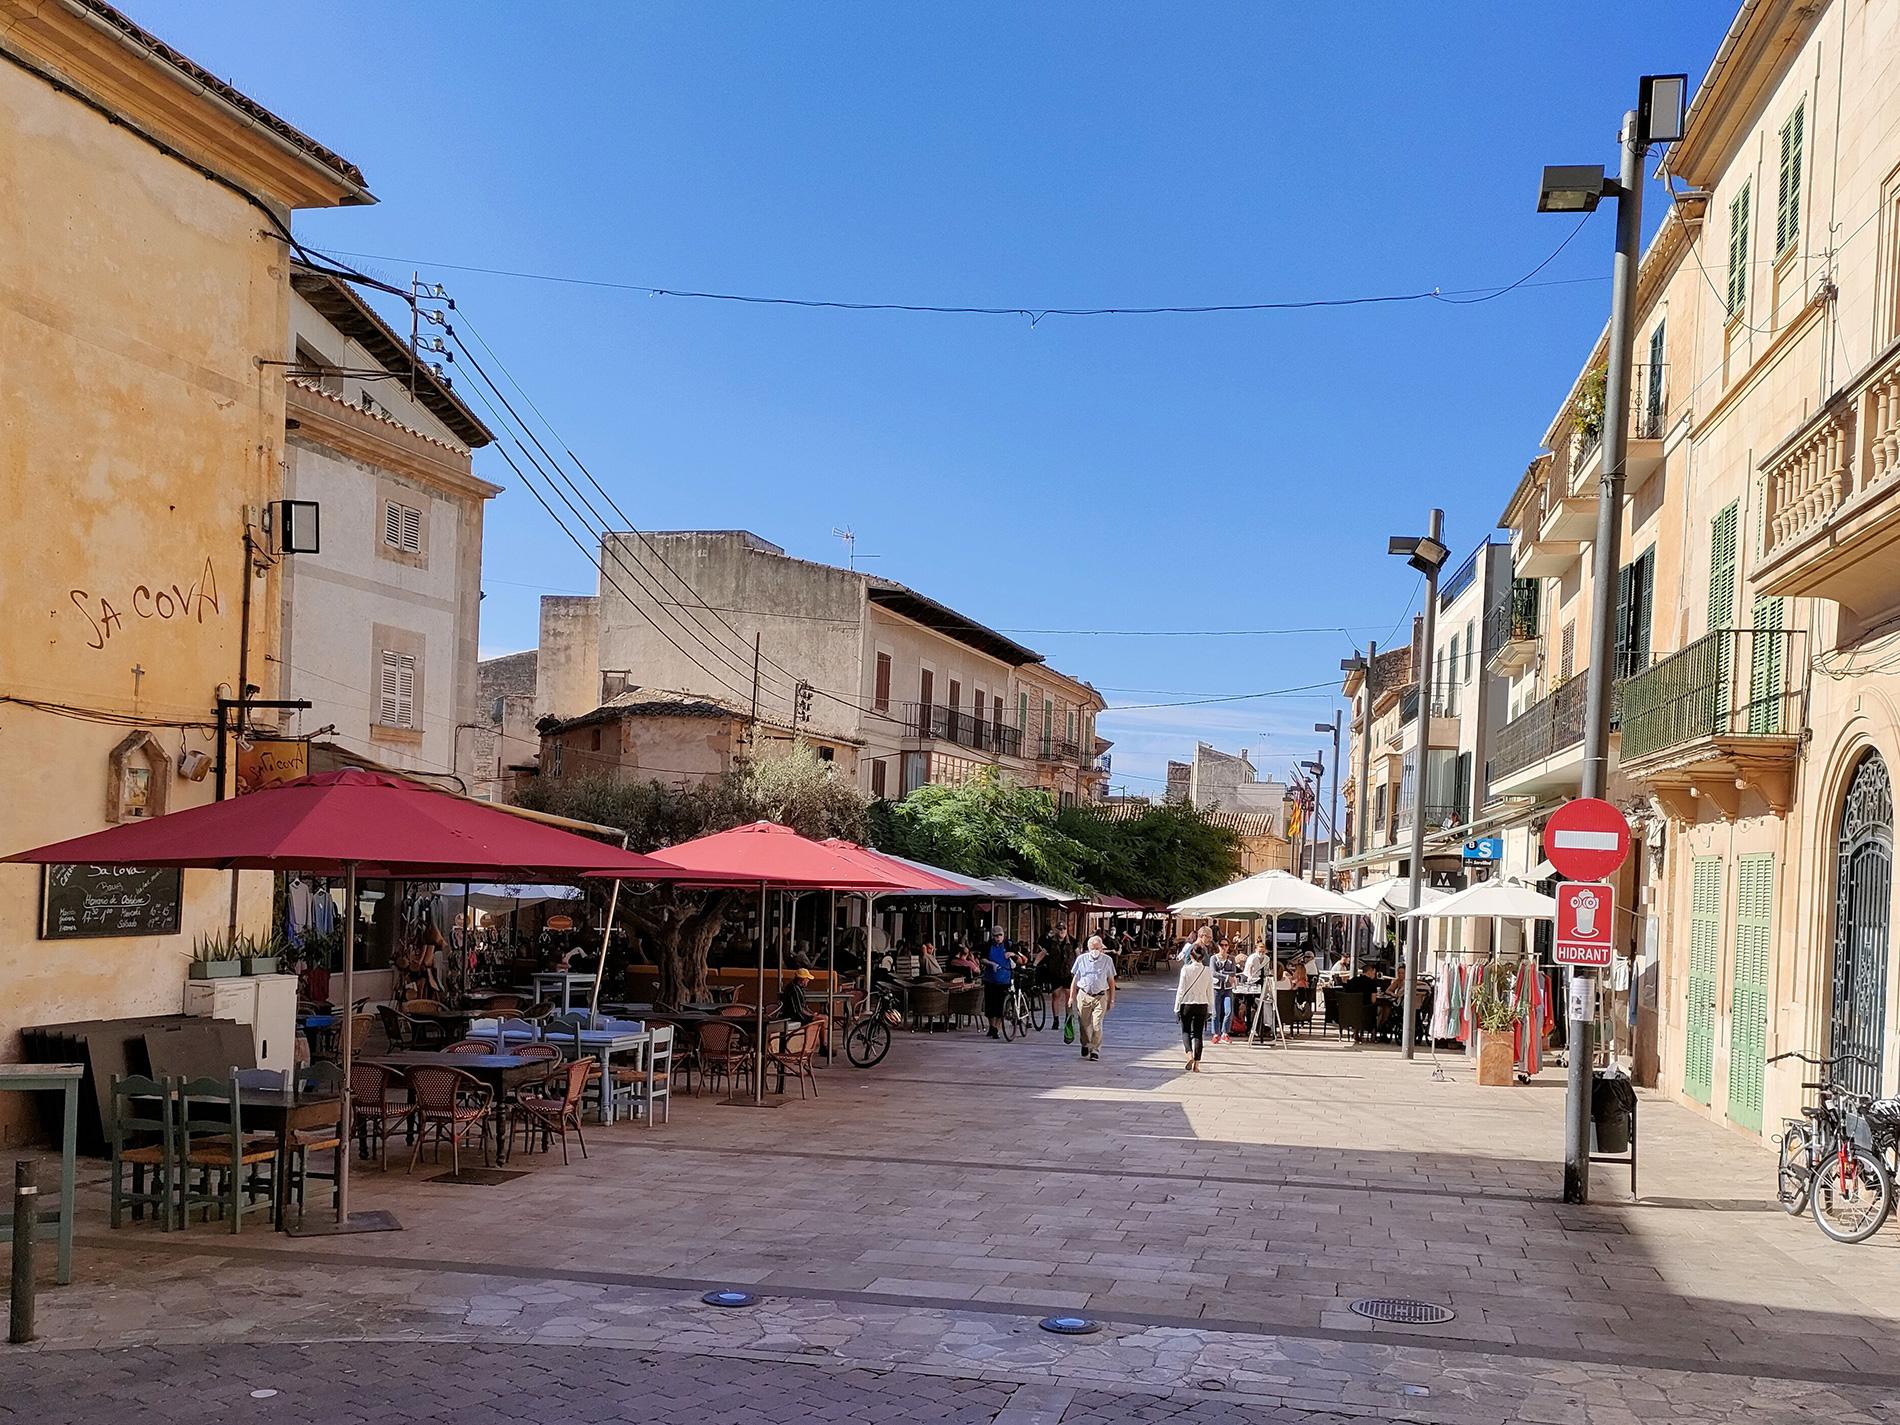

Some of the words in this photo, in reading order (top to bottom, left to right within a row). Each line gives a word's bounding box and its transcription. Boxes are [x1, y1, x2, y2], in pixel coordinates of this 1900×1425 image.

[70, 589, 122, 650] SA
[132, 555, 220, 624] COVA
[276, 746, 304, 770] COVA
[1478, 841, 1492, 858] S
[1558, 947, 1609, 962] HIDRANT
